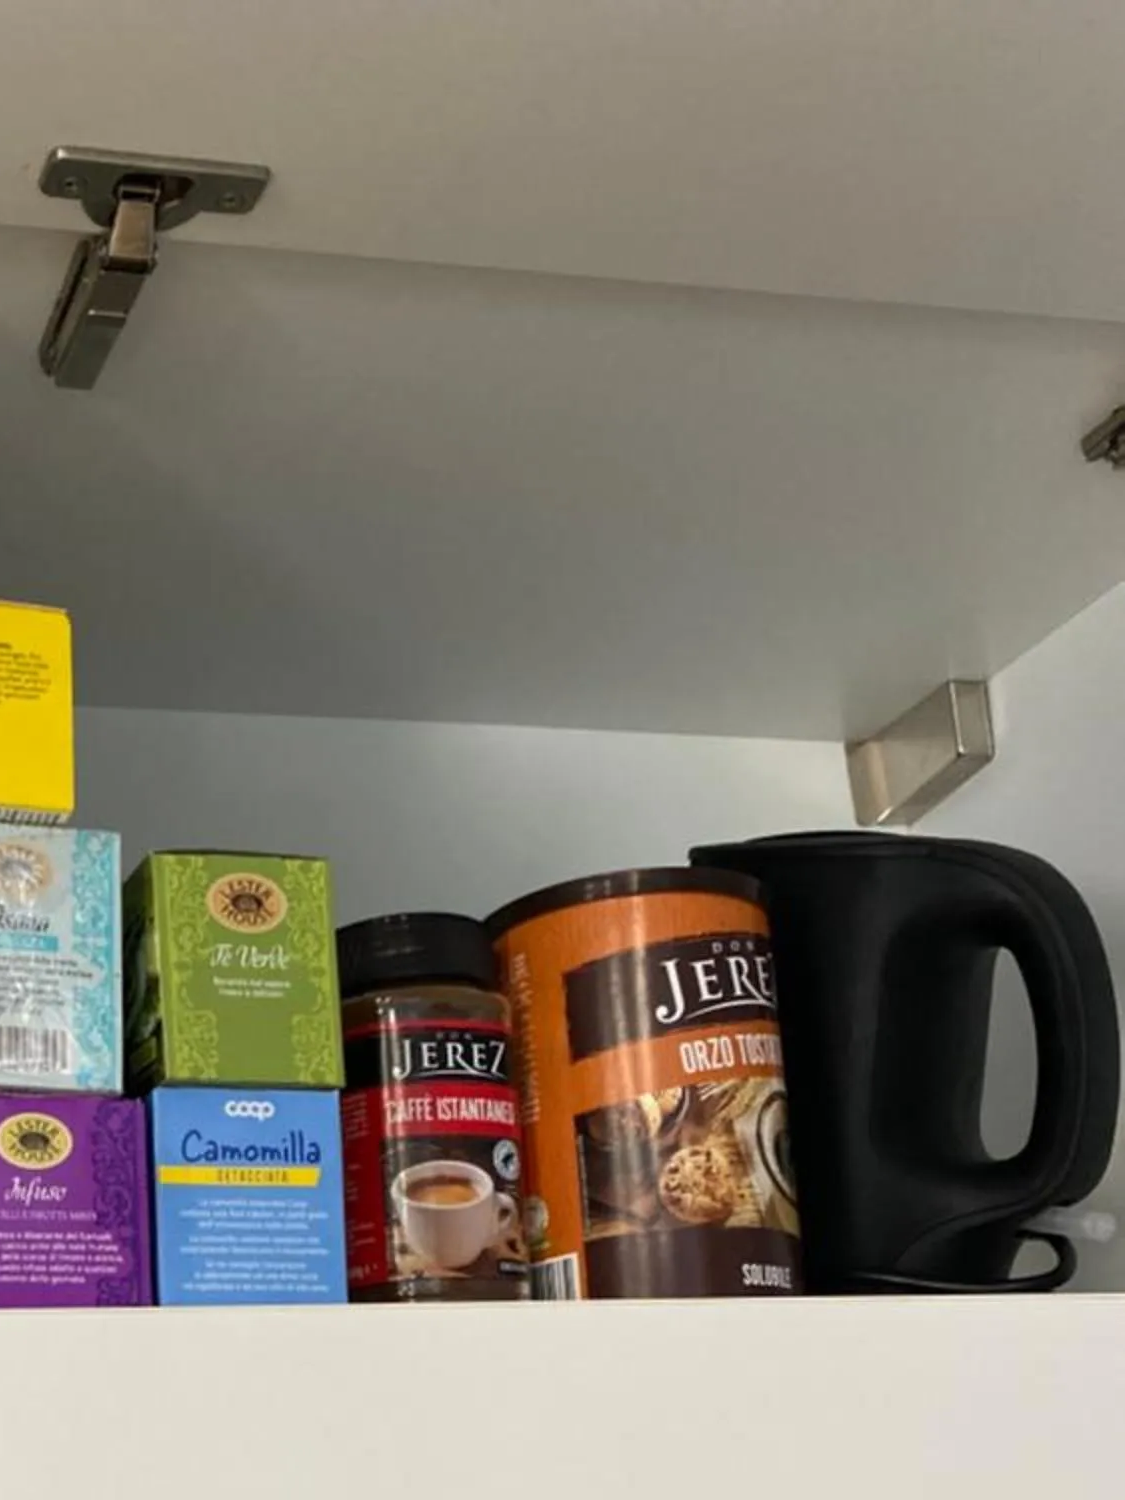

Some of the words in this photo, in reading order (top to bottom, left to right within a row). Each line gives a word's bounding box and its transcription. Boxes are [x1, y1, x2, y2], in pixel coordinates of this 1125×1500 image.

[219, 880, 275, 900] LESTER
[236, 942, 290, 970] Verde
[655, 954, 777, 1023] JERE
[392, 1039, 507, 1080] JEREZ
[679, 1034, 735, 1074] ORZO
[225, 1100, 276, 1121] coop
[181, 1129, 321, 1164] Camomilla
[3, 1175, 68, 1207] Infuso
